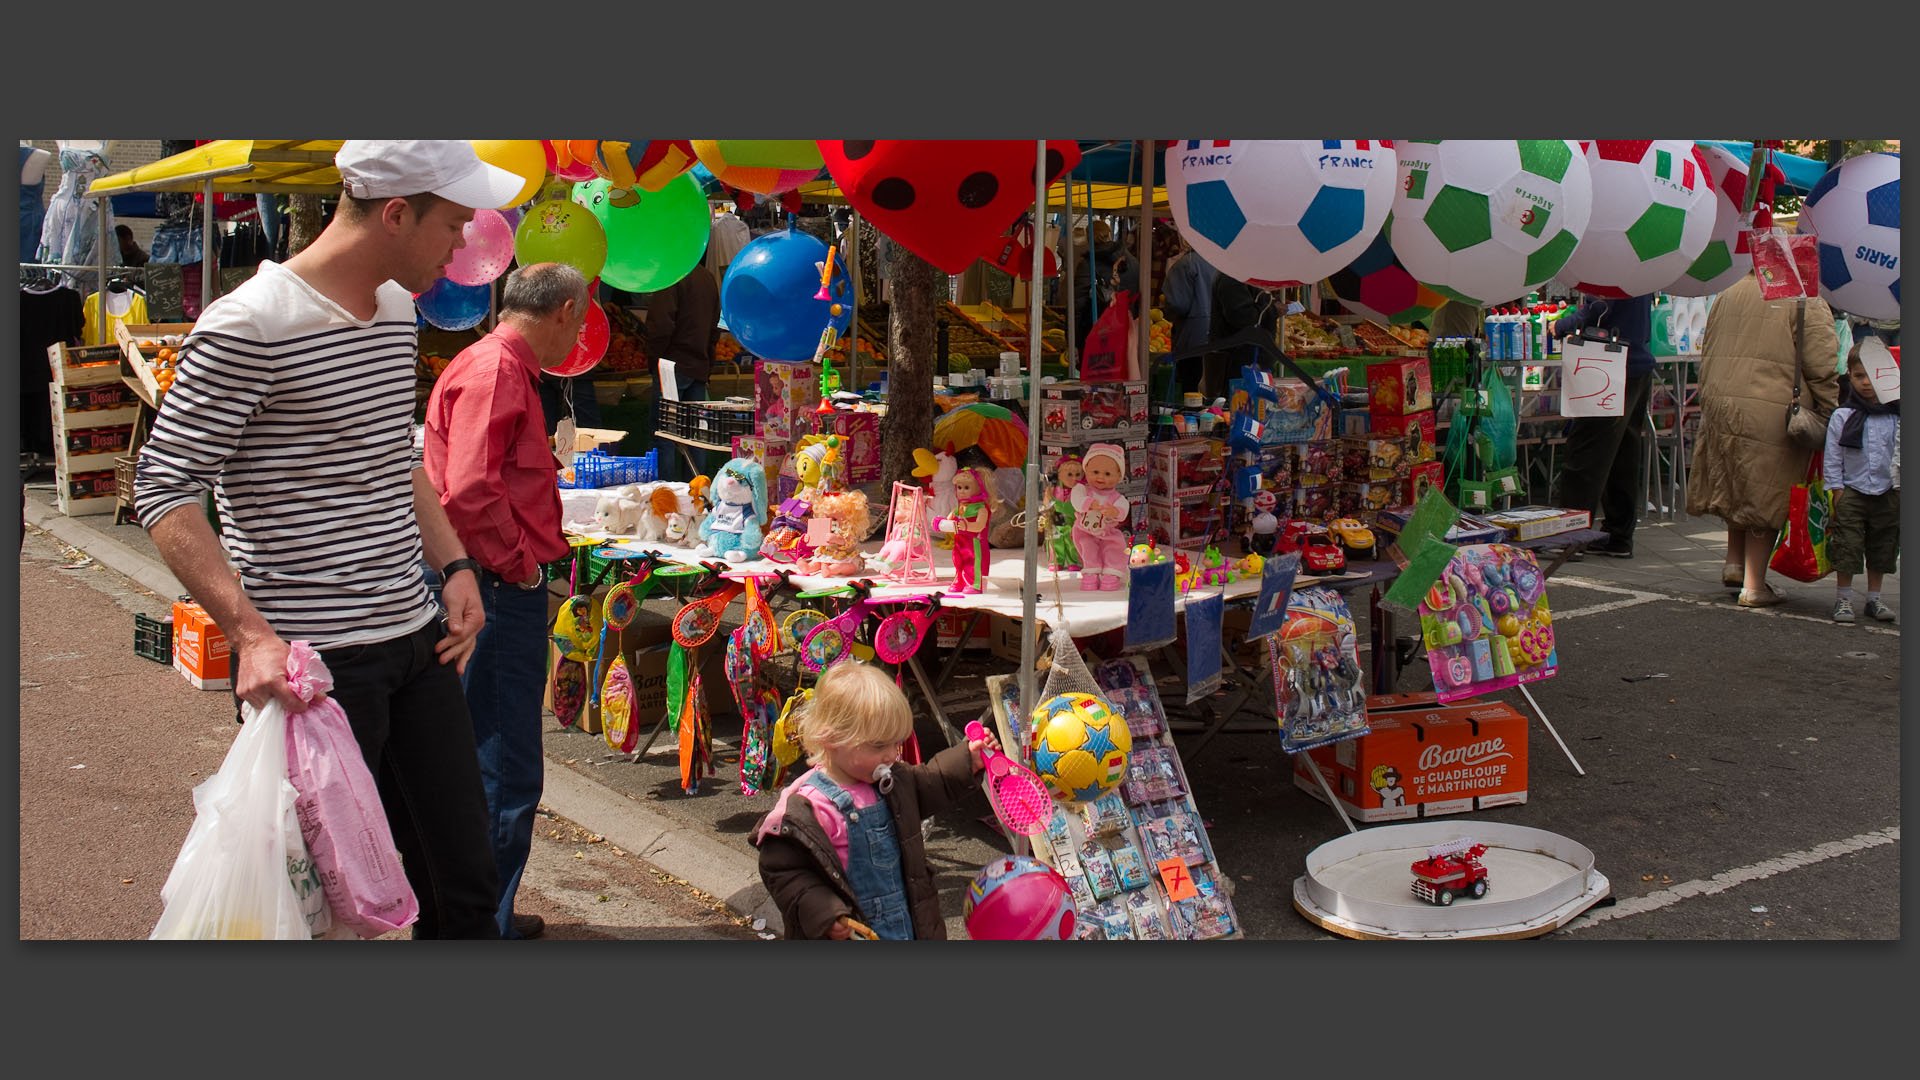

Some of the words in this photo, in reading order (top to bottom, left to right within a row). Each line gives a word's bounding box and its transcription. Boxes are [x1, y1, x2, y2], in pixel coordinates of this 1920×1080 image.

[1182, 154, 1232, 170] FRANCE
[1318, 154, 1374, 170] FRANCE
[1400, 159, 1432, 171] Algeria
[1653, 177, 1694, 197] ITALY
[1514, 187, 1555, 211] Algeria
[1855, 245, 1898, 270] PARIS
[1418, 736, 1514, 771] Banane
[1412, 776, 1426, 785] DE
[1427, 764, 1507, 784] GUADELOUPE
[1416, 785, 1425, 795] &
[1427, 776, 1503, 794] MARTINIQUE
[1161, 865, 1188, 893] 7
